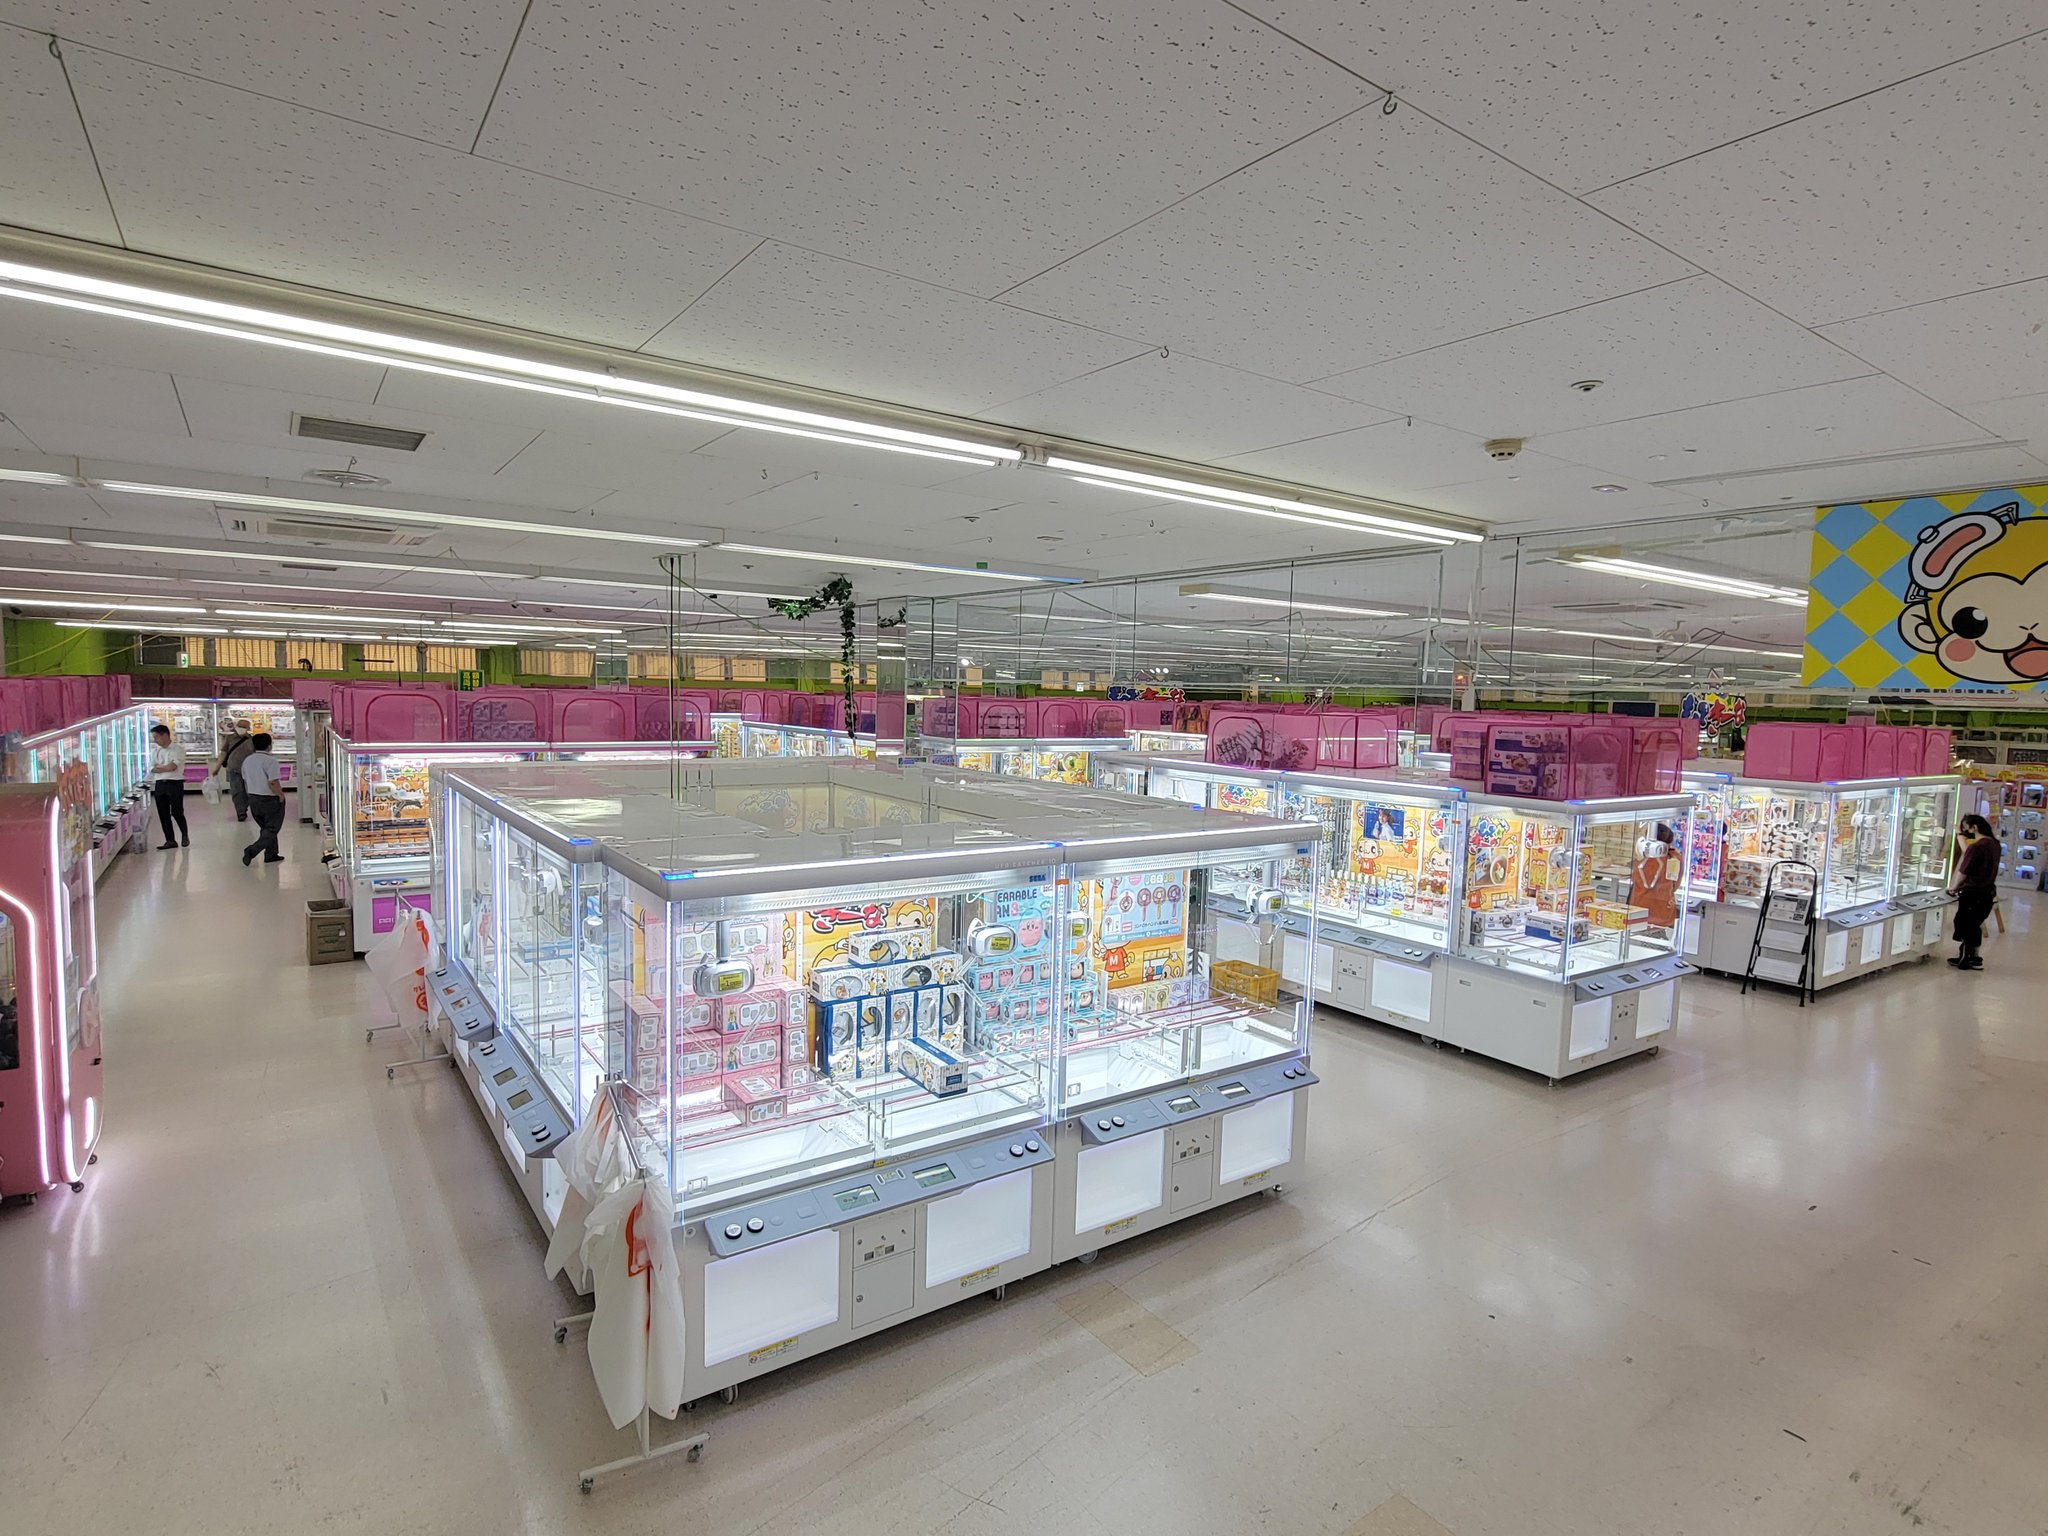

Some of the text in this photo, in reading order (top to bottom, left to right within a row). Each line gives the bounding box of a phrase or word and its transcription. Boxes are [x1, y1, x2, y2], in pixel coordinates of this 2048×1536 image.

[1029, 874, 1047, 883] SEGA
[997, 888, 1038, 903] EARABLE
[996, 903, 1010, 918] AN
[1109, 954, 1120, 967] M
